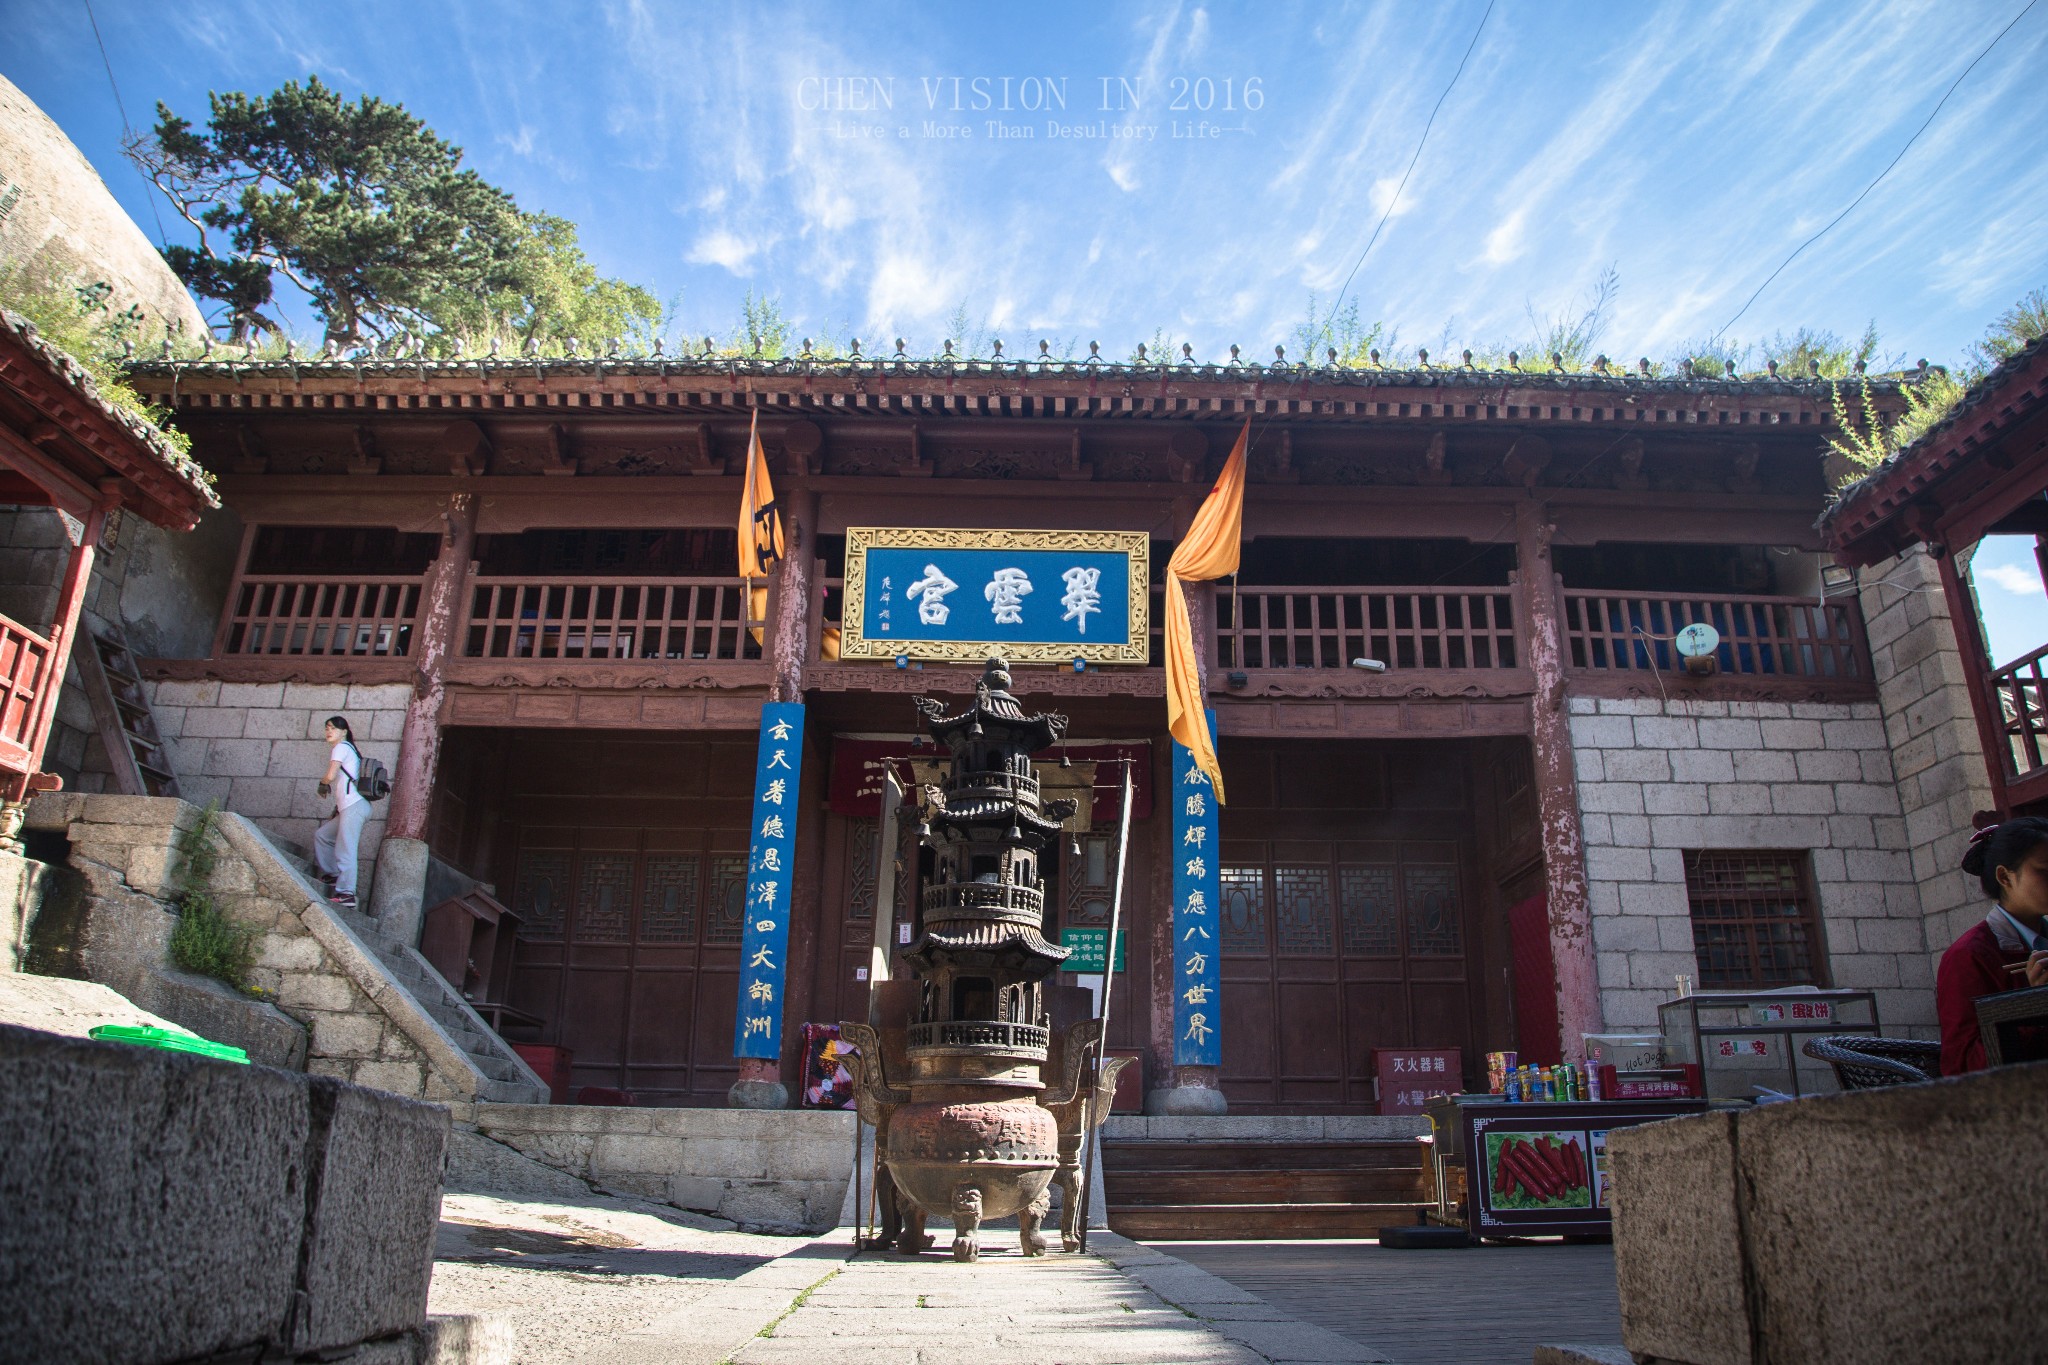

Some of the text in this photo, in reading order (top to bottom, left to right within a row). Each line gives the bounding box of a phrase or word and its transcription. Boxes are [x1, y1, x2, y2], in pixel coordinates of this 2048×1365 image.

[1068, 933, 1104, 942] 信仰自
[1393, 1057, 1446, 1073] 灭火器箱
[1625, 1056, 1643, 1072] Hot
